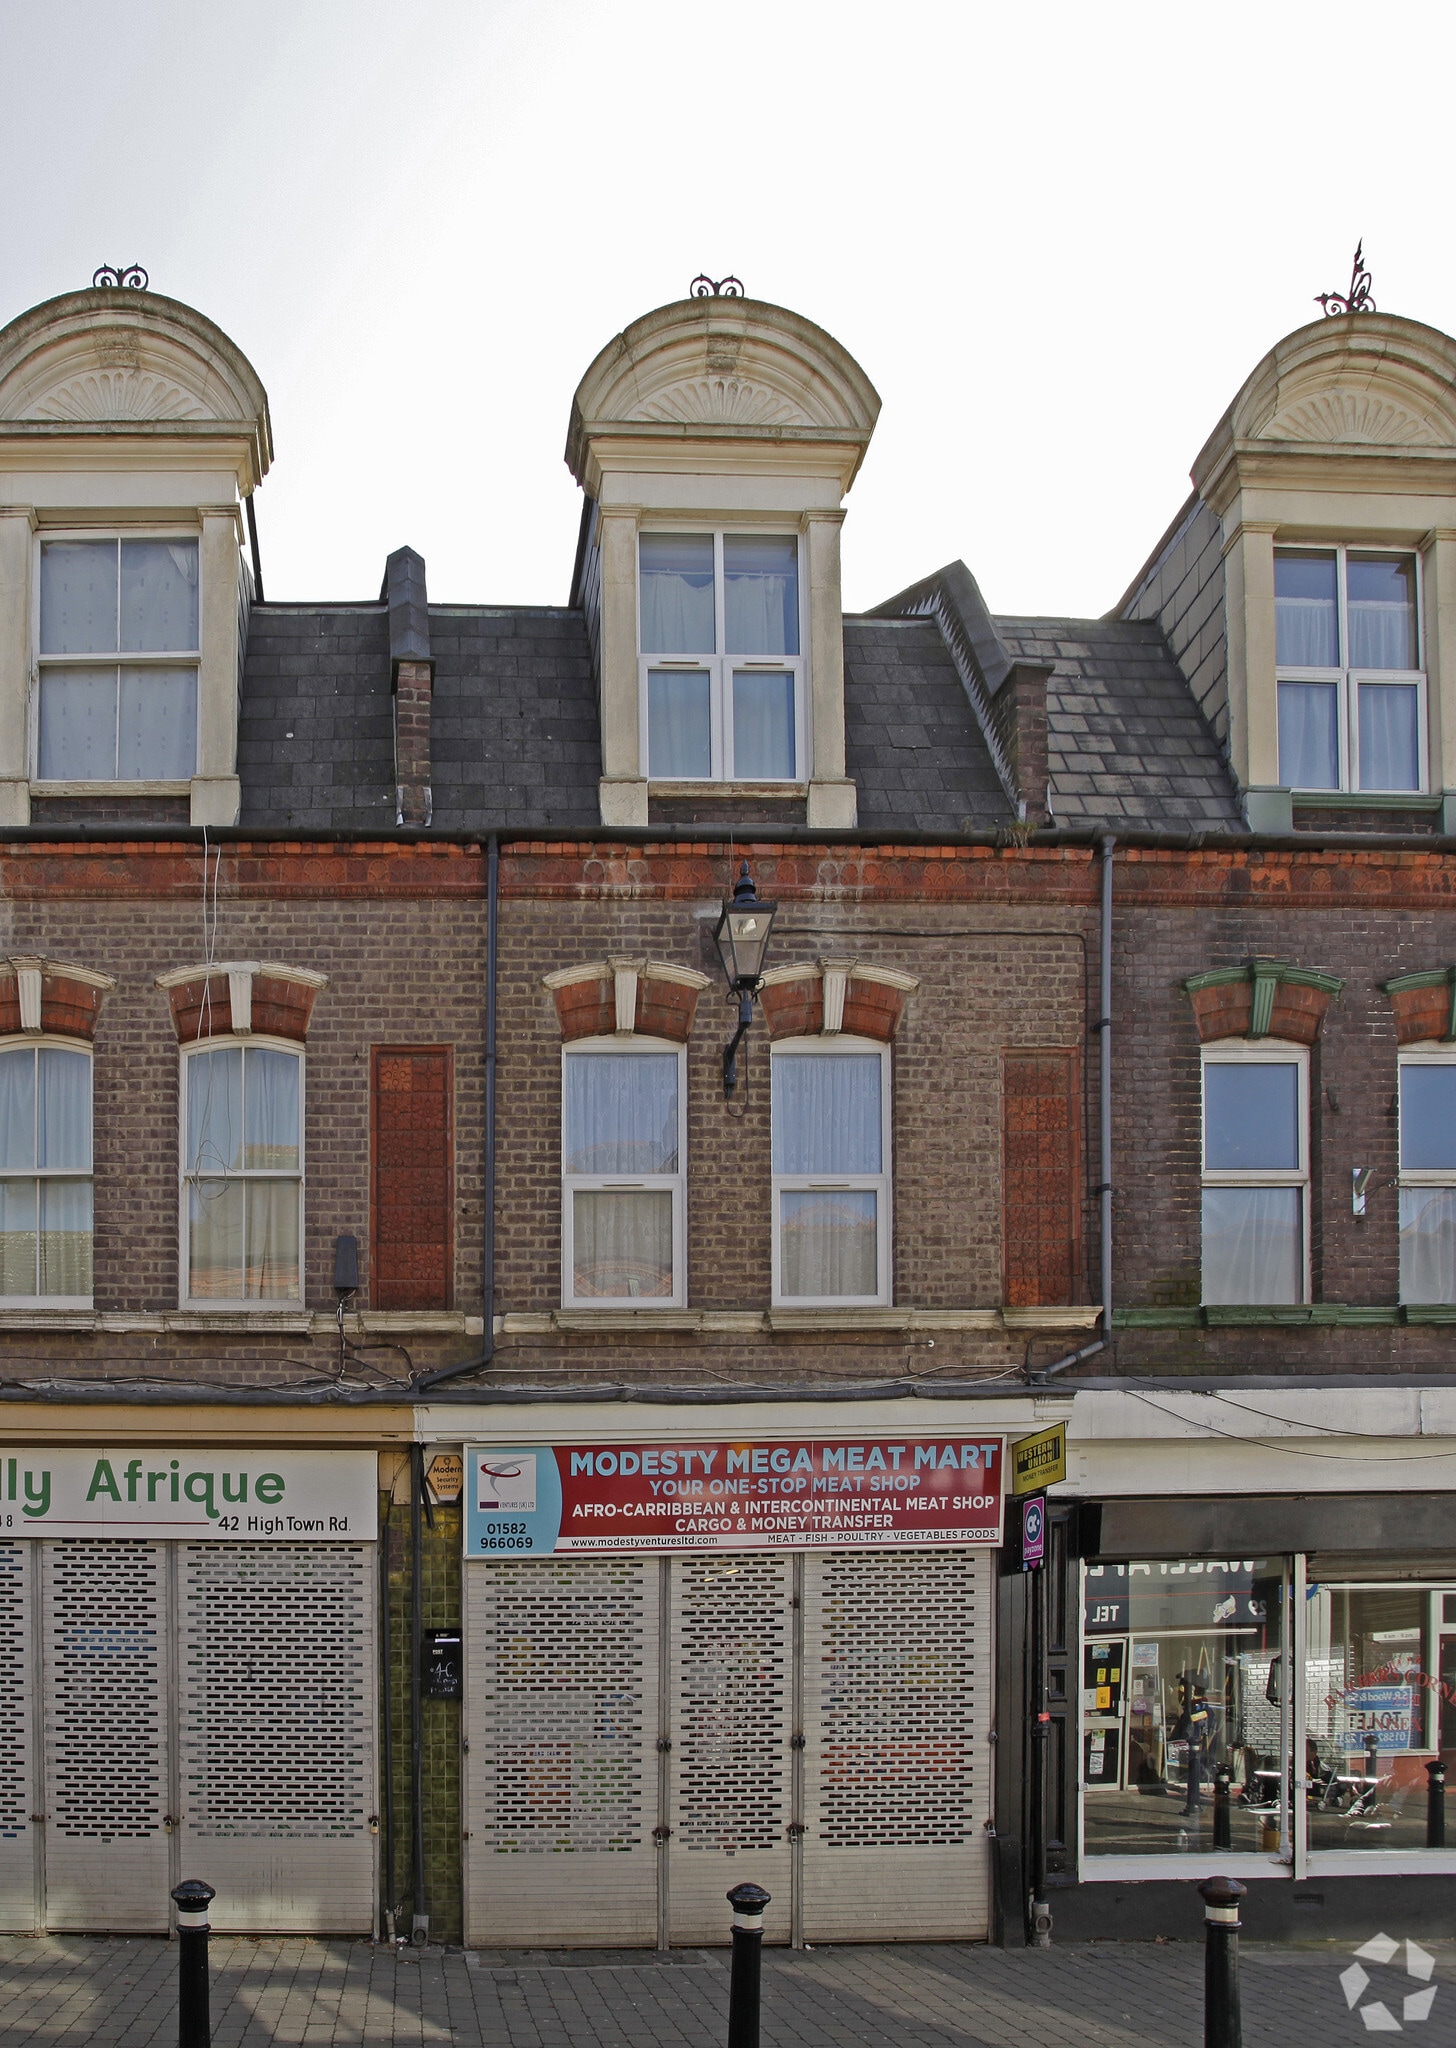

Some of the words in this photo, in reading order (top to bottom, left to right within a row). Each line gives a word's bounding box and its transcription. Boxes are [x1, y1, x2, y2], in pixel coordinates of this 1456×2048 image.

[570, 1450, 718, 1477] MODESTY
[726, 1448, 813, 1474] MEGA
[822, 1446, 905, 1472] MEAT
[914, 1445, 998, 1470] MART
[1017, 1440, 1053, 1463] WESTERN
[1027, 1450, 1053, 1469] UNION
[433, 1465, 462, 1473] Modern
[1022, 1471, 1037, 1482] MONEY
[1037, 1463, 1059, 1476] TRANSFER
[0, 1458, 51, 1517] ly
[86, 1459, 286, 1519] Afrique
[650, 1479, 703, 1496] YOUR
[709, 1477, 807, 1495] ONE-STOP
[812, 1476, 864, 1493] MEAT
[870, 1475, 921, 1491] SHOP
[572, 1501, 725, 1517] AFRO-CARRIBBEAN
[730, 1501, 740, 1514] &
[745, 1498, 901, 1514] INTERCONTINENTAL
[906, 1497, 948, 1511] MEAT
[952, 1495, 994, 1509] SHOP
[218, 1516, 239, 1531] 42
[248, 1516, 284, 1535] High
[286, 1516, 324, 1531] Town
[329, 1516, 351, 1531] Rd.
[487, 1522, 527, 1535] 01582
[675, 1518, 732, 1532] CARGO
[737, 1518, 747, 1531] &
[751, 1516, 807, 1530] MONEY
[812, 1514, 893, 1529] TRANSFER
[480, 1537, 533, 1549] 966069
[571, 1535, 717, 1548] www.modestyventuresltd.com
[768, 1534, 796, 1543] MEAT
[805, 1533, 828, 1543] FISH
[837, 1532, 884, 1542] POULTRY
[893, 1530, 958, 1540] VEGETABLES
[960, 1529, 996, 1539] FOODS
[1024, 1543, 1042, 1555] payzone
